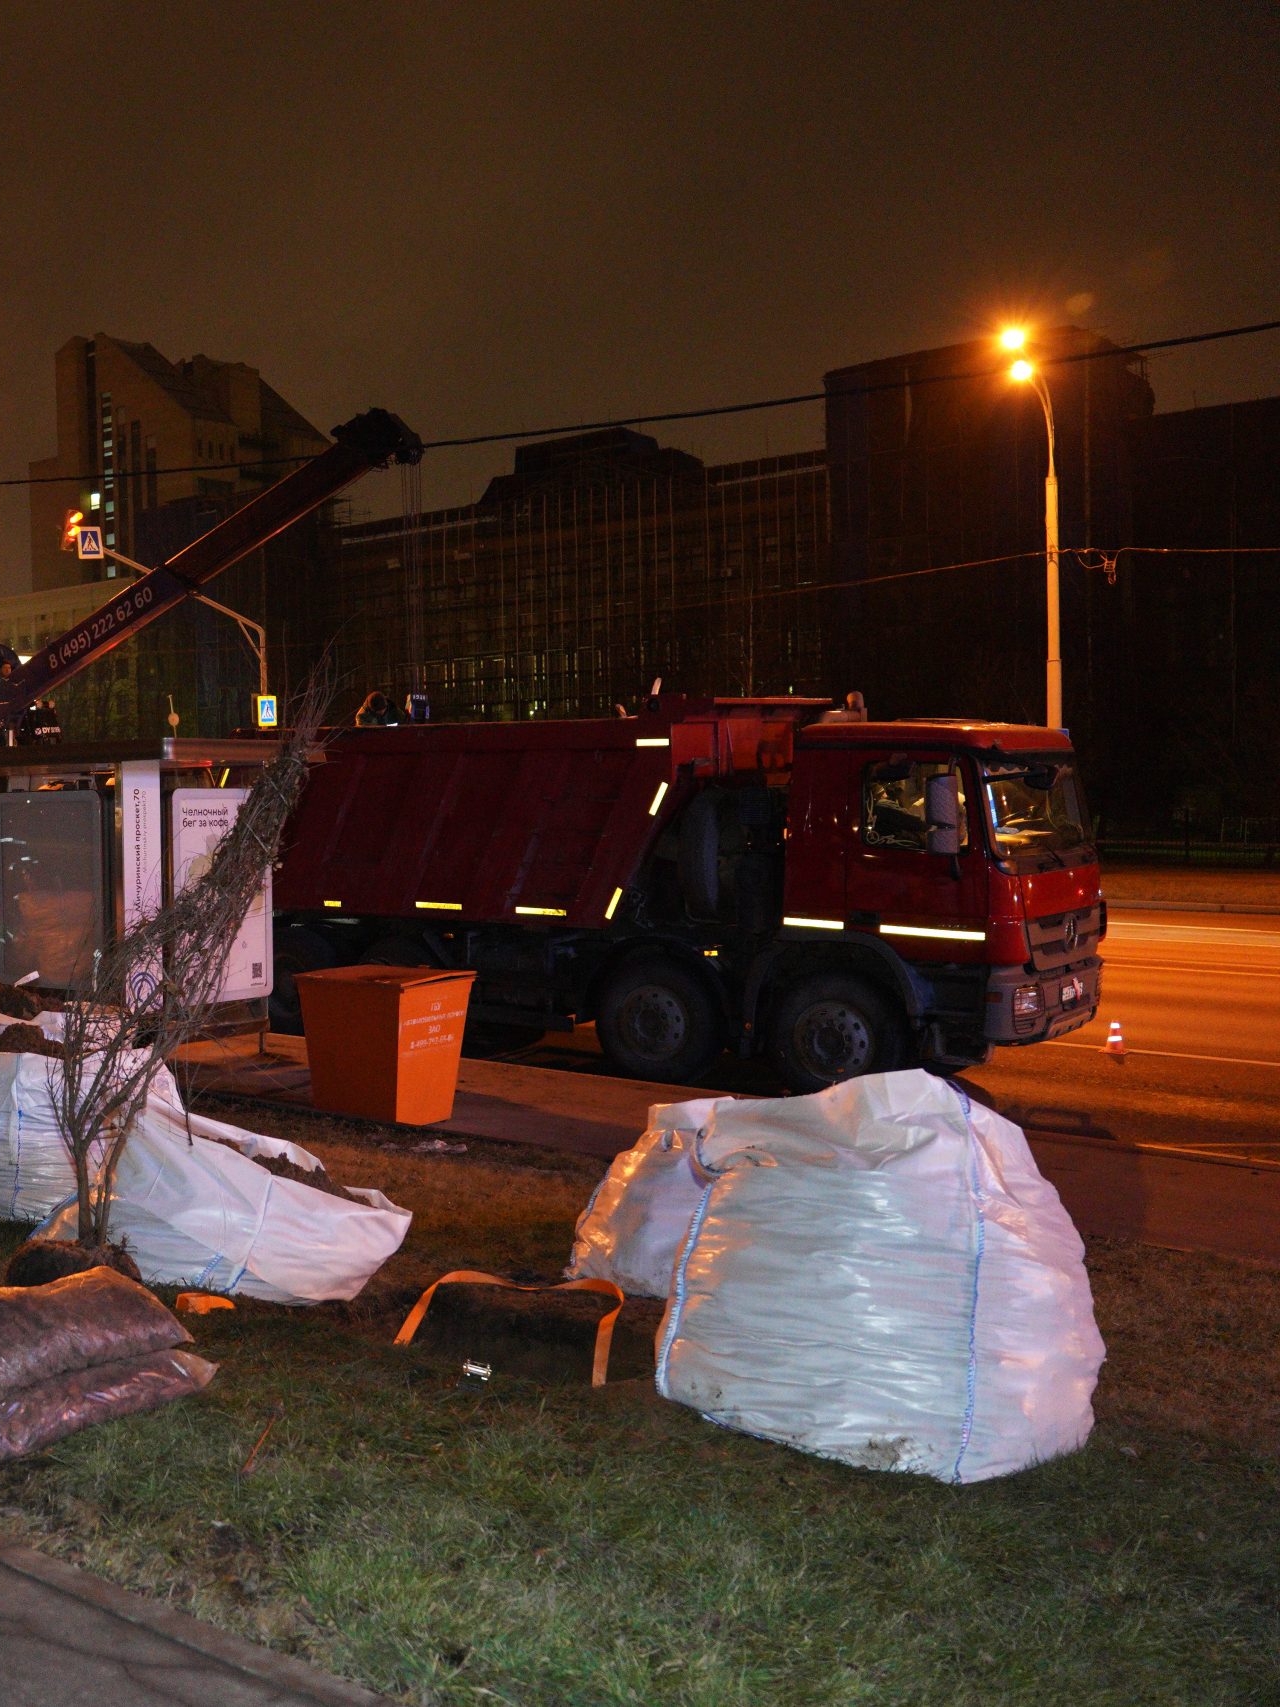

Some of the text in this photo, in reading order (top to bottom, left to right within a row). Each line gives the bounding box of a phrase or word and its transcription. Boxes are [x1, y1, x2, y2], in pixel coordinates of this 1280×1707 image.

[49, 586, 152, 669] 8 (495) 222 62 60
[181, 806, 228, 816] Челночный
[182, 817, 229, 828] бег за кофе
[134, 844, 142, 911] Мичуринский
